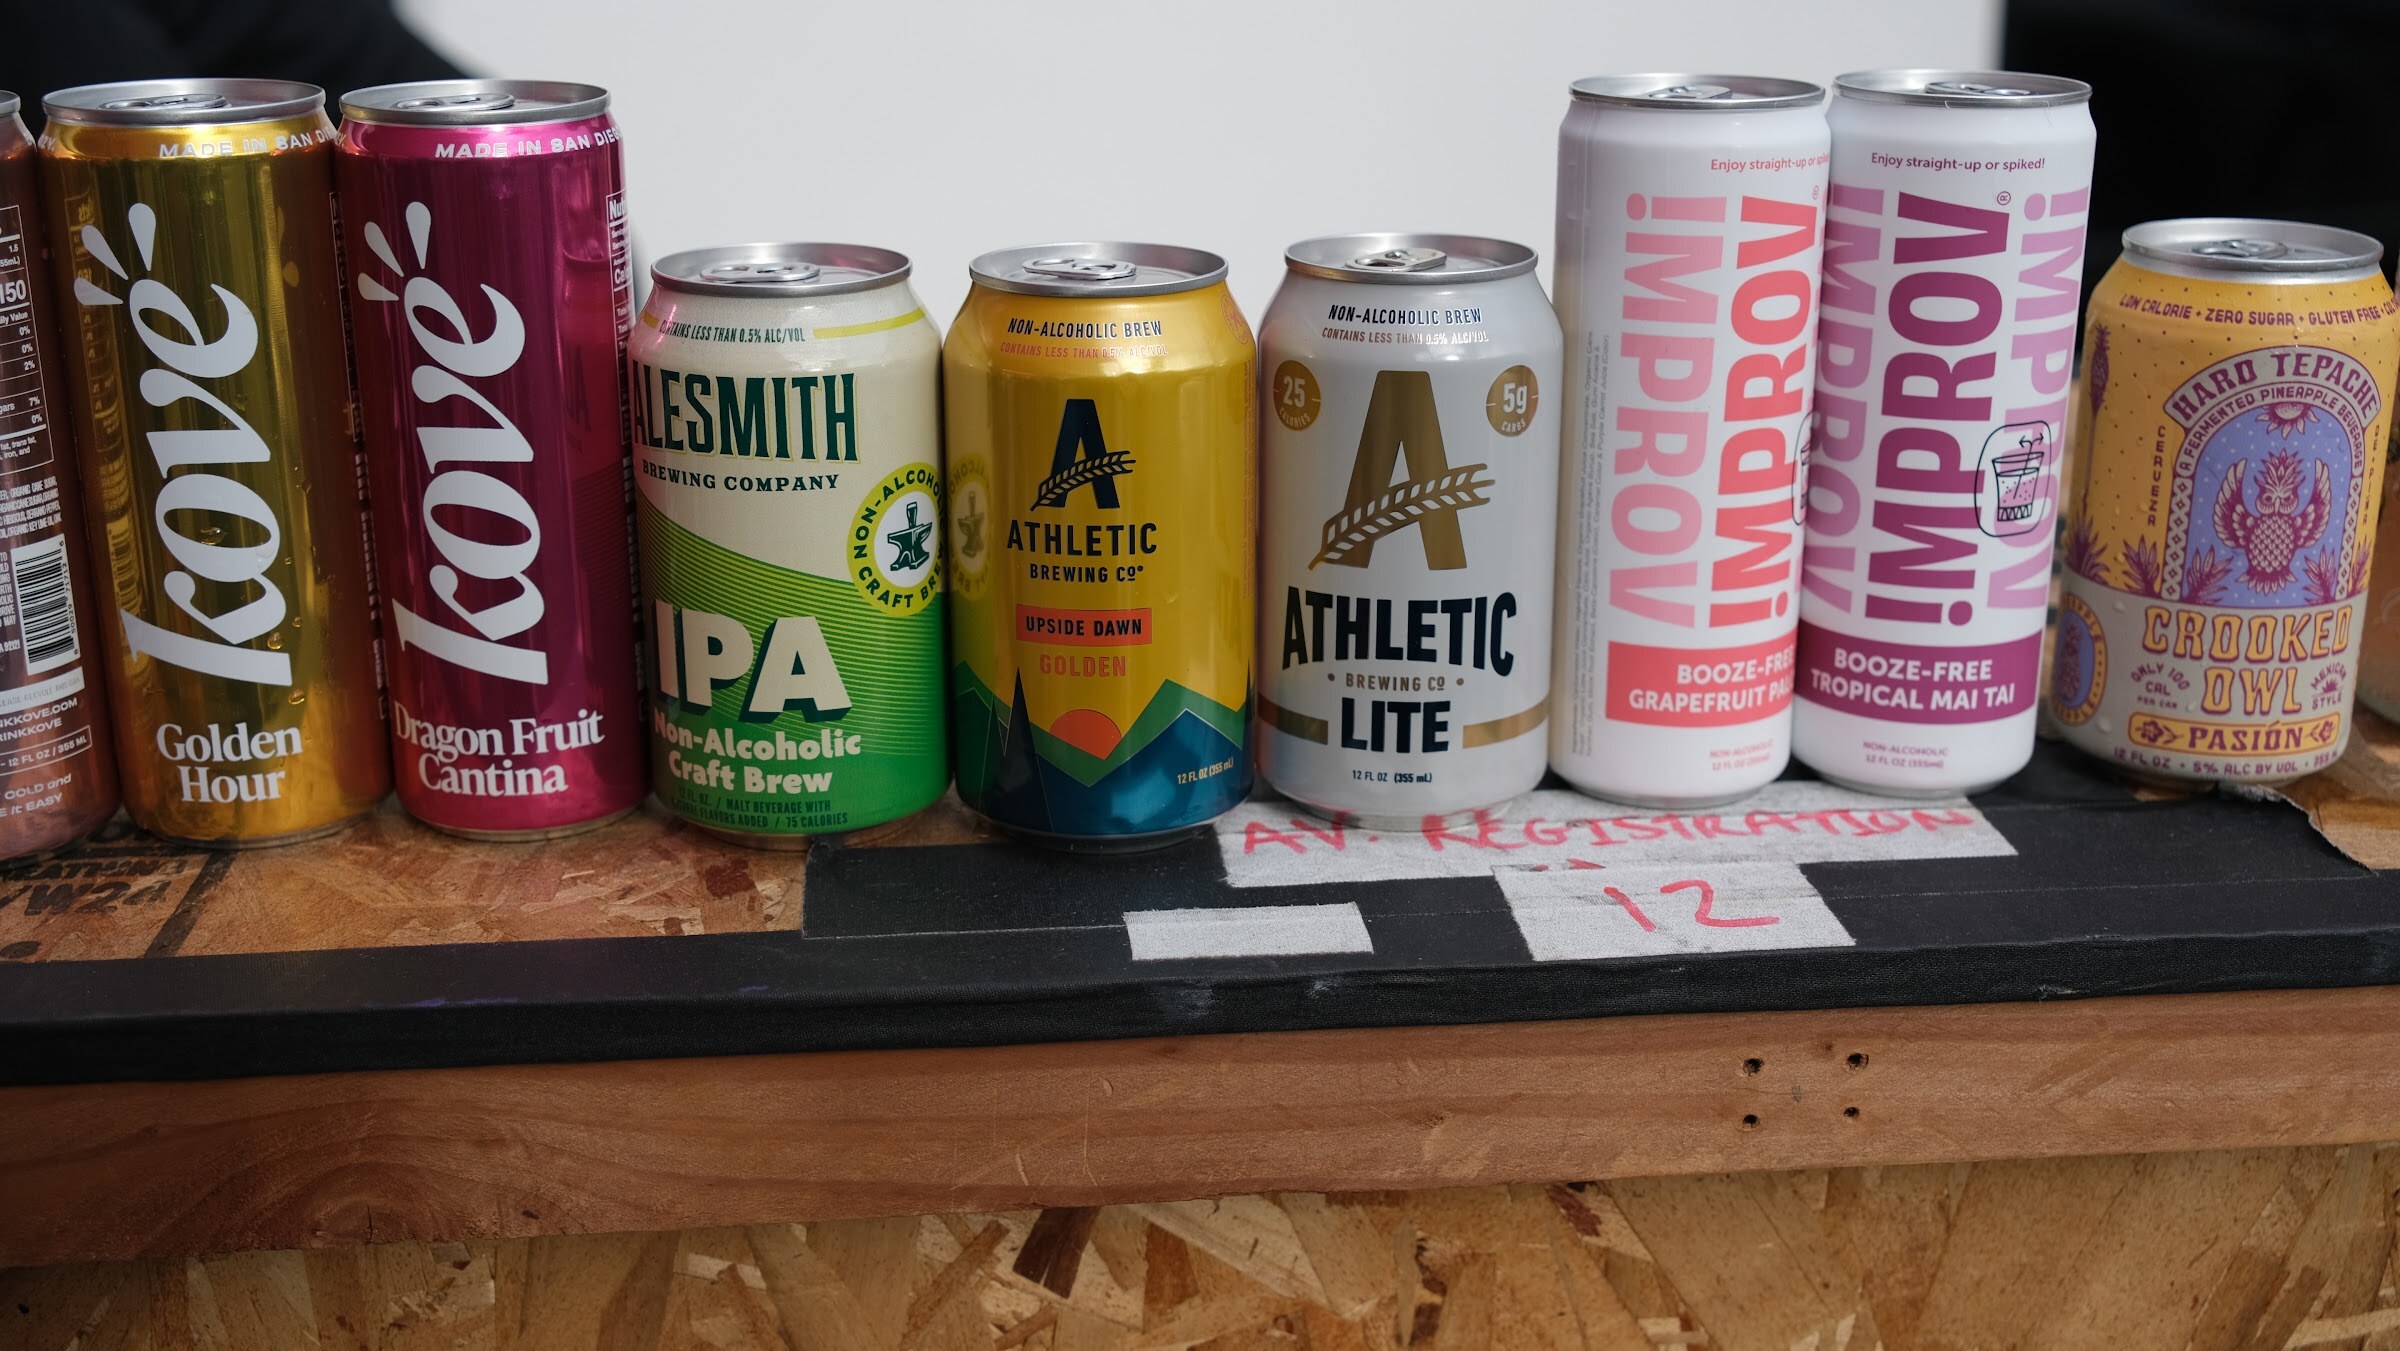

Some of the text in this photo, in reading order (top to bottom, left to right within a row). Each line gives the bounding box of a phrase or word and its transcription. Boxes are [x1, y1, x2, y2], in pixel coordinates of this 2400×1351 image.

[159, 140, 232, 158] MADE
[243, 138, 266, 152] IN
[276, 131, 313, 150] SAN
[435, 142, 508, 158] MADE
[519, 141, 542, 155] IN
[551, 134, 591, 151] SAN
[1711, 158, 1747, 173] Enjoy
[1749, 156, 1807, 172] straight-up
[1808, 155, 1816, 166] or
[1871, 152, 2045, 172] Enjoy straight-up or spiked!
[10, 311, 29, 325] Value
[1327, 304, 1483, 325] NON-ALCOHOLIC BREW
[2141, 300, 2192, 319] CALORIE
[2205, 308, 2244, 325] ZERO
[2248, 311, 2296, 327] SUGAR
[2308, 310, 2356, 327] GLUTEN
[2358, 305, 2381, 321] FREE
[19, 326, 30, 336] 0%
[690, 325, 712, 341] LESS
[713, 327, 737, 343] THAN
[739, 328, 761, 343] 0.5%
[764, 327, 806, 344] ALC/VOL
[1007, 317, 1163, 339] NON-ALCOHOLIC BREW
[1321, 327, 1366, 343] CONTAINS
[1368, 331, 1393, 344] LESS
[1396, 333, 1423, 345] THAN
[22, 344, 33, 354] 0%
[1000, 341, 1042, 357] CONTAINS
[1045, 346, 1069, 358] LESS
[1073, 347, 1099, 359] THAN
[24, 361, 35, 371] 2%
[1283, 375, 1305, 408] 25
[1503, 382, 1528, 415] 5g
[2172, 352, 2379, 422] HARD TEPACHE
[2184, 392, 2256, 460] FERMENTED
[2260, 386, 2338, 411] PINEAPPLE
[2337, 404, 2364, 470] BEVERAGE
[642, 460, 840, 492] BREWING COMPANY
[1006, 519, 1158, 556] ATHLETIC
[858, 566, 914, 608] CRAFT
[1029, 563, 1108, 584] BREWING
[1025, 615, 1142, 637] UPSIDE DAWN
[1282, 585, 1518, 678] ATHLETIC
[2141, 604, 2353, 663] CROOKED
[655, 599, 853, 723] IPA
[1039, 654, 1127, 678] GOLDEN
[1834, 647, 1993, 683] BOOZE-FREE
[1345, 672, 1421, 692] BREWING
[2130, 662, 2191, 692] ONLY 100
[2145, 681, 2171, 697] CAL
[2310, 661, 2348, 690] MEXICAN
[1628, 685, 1766, 713] GRAPEFRUIT
[1810, 668, 1924, 710] TROPICAL
[1930, 688, 1978, 711] MAI
[1984, 682, 2016, 709] TAI
[2200, 666, 2303, 717] OWL
[2311, 692, 2343, 711] STYLE
[395, 701, 605, 763] Dragon Fruit
[653, 707, 862, 761] Non-Alcoholic
[1341, 696, 1451, 753] LITE
[2187, 719, 2304, 751] PASIÓN
[156, 722, 303, 762] Golden
[22, 754, 34, 763] FL
[36, 749, 50, 760] OZ
[2130, 750, 2148, 765] FL
[2152, 755, 2172, 769] OZ
[2192, 760, 2219, 774] 5%
[2223, 761, 2251, 776] ALC
[2255, 760, 2272, 775] BY
[177, 765, 286, 803] Hour
[418, 752, 569, 797] Cantina
[668, 750, 834, 794] Craft Brew
[1177, 773, 1187, 785] 12
[1188, 770, 1198, 782] FL
[1198, 767, 1208, 780] OZ
[1352, 770, 1362, 781] 12
[1364, 771, 1375, 782] FL
[1377, 771, 1388, 782] OZ
[4, 773, 72, 800] COLD and
[26, 793, 63, 811] EASY
[726, 798, 750, 813] MALT
[752, 801, 802, 814] BEVERAGE
[805, 799, 831, 812] WITH
[738, 812, 769, 828] ADDED
[786, 816, 798, 828] 75
[801, 812, 848, 828] CALORIES
[1420, 798, 1973, 854] REGISTRATION
[1603, 878, 1781, 932] 12
